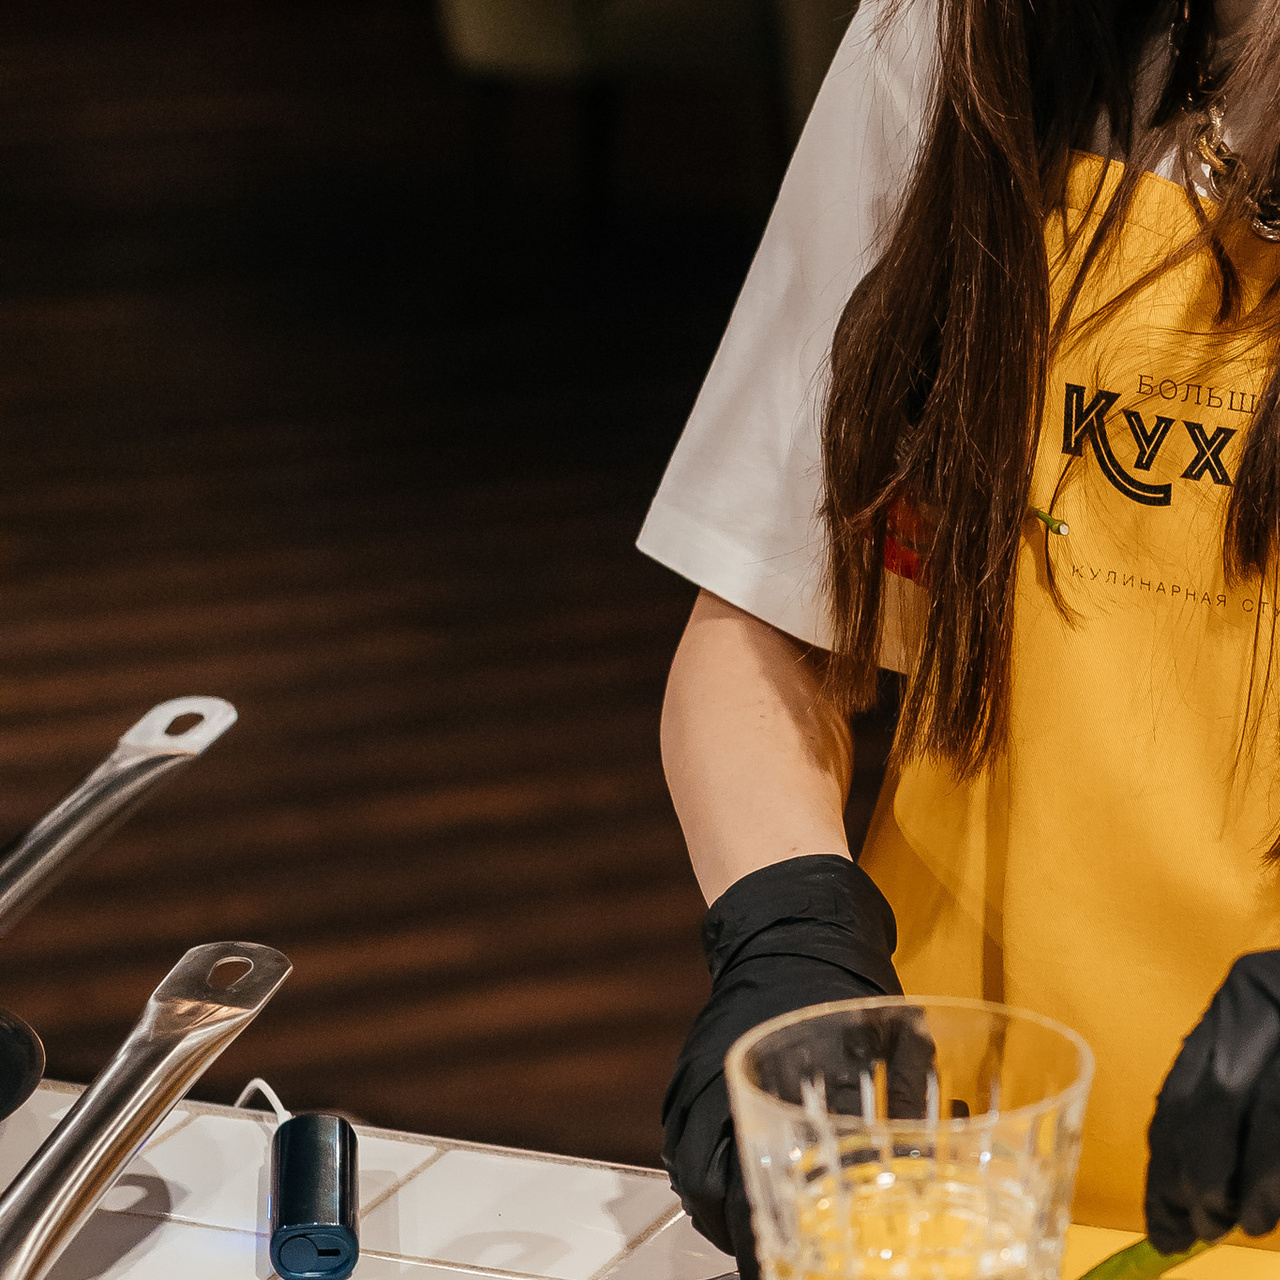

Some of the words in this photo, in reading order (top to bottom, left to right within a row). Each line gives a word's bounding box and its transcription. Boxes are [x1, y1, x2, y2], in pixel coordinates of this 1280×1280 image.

[1136, 373, 1259, 415] БОЛЬШ
[1062, 382, 1238, 507] КУХ
[1071, 564, 1228, 608] КУЛИНАРНАЯ
